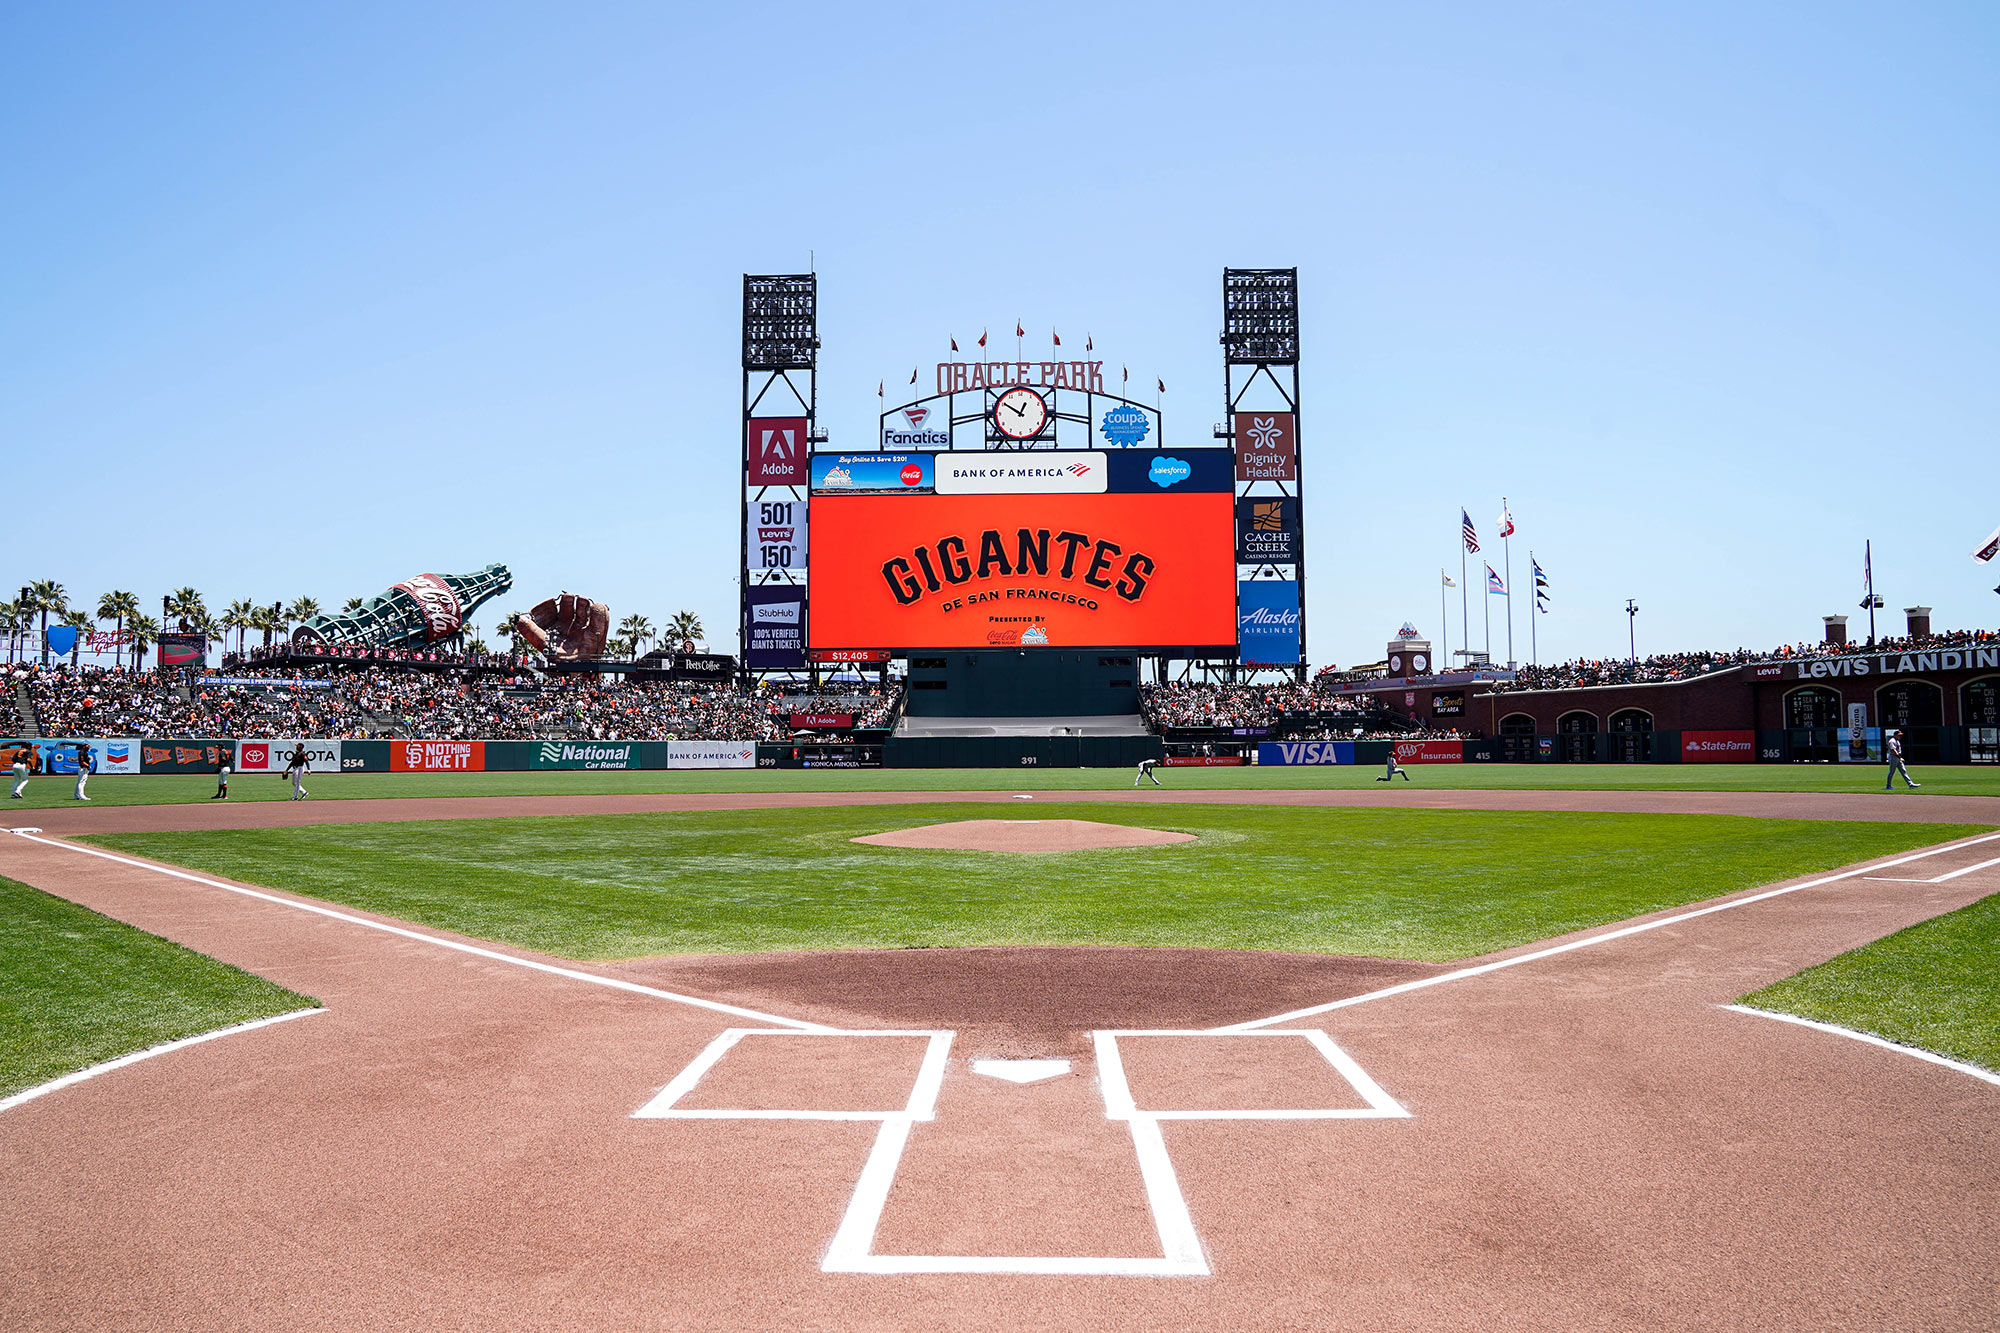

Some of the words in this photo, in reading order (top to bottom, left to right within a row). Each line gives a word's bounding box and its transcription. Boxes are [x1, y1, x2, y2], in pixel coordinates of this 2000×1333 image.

[936, 361, 1031, 396] ORACLE
[1039, 361, 1105, 395] PARK
[1108, 414, 1145, 426] coupa
[884, 430, 948, 444] Fanatics
[1244, 452, 1286, 466] Dignity
[761, 462, 794, 474] Adobe
[953, 470, 986, 478] BANK
[990, 469, 1005, 477] OF
[1008, 468, 1064, 477] AMERICA
[1154, 467, 1188, 475] salesforce
[1246, 466, 1286, 478] Health
[760, 502, 792, 525] 501
[1244, 532, 1290, 542] CACHE
[1246, 542, 1289, 552] CREEK
[881, 528, 1156, 606] GIGANTES
[942, 599, 964, 613] DE
[967, 590, 1000, 604] SAN
[1006, 589, 1099, 611] FRANCISCO
[758, 608, 794, 618] StubHub
[1240, 608, 1298, 626] Alaska
[754, 628, 770, 639] 100%
[772, 628, 799, 638] VERIFIED
[752, 640, 774, 650] GIANTS
[776, 640, 801, 649] TICKETS
[832, 652, 868, 661] $12,405
[1880, 648, 1998, 673] LANDIN
[702, 660, 720, 671] Coffee
[1246, 658, 1272, 668] Coors
[1442, 696, 1463, 706] Sports
[1852, 708, 1861, 738] Corona
[426, 744, 471, 756] NOTHING
[562, 745, 631, 760] National
[1276, 743, 1337, 764] VISA
[1762, 749, 1780, 758] 365
[275, 751, 336, 762] TOOTA
[426, 755, 452, 768] LIKE
[455, 754, 470, 768] IT
[1476, 752, 1490, 760] 415
[343, 758, 365, 768] 354
[760, 758, 776, 766] 399
